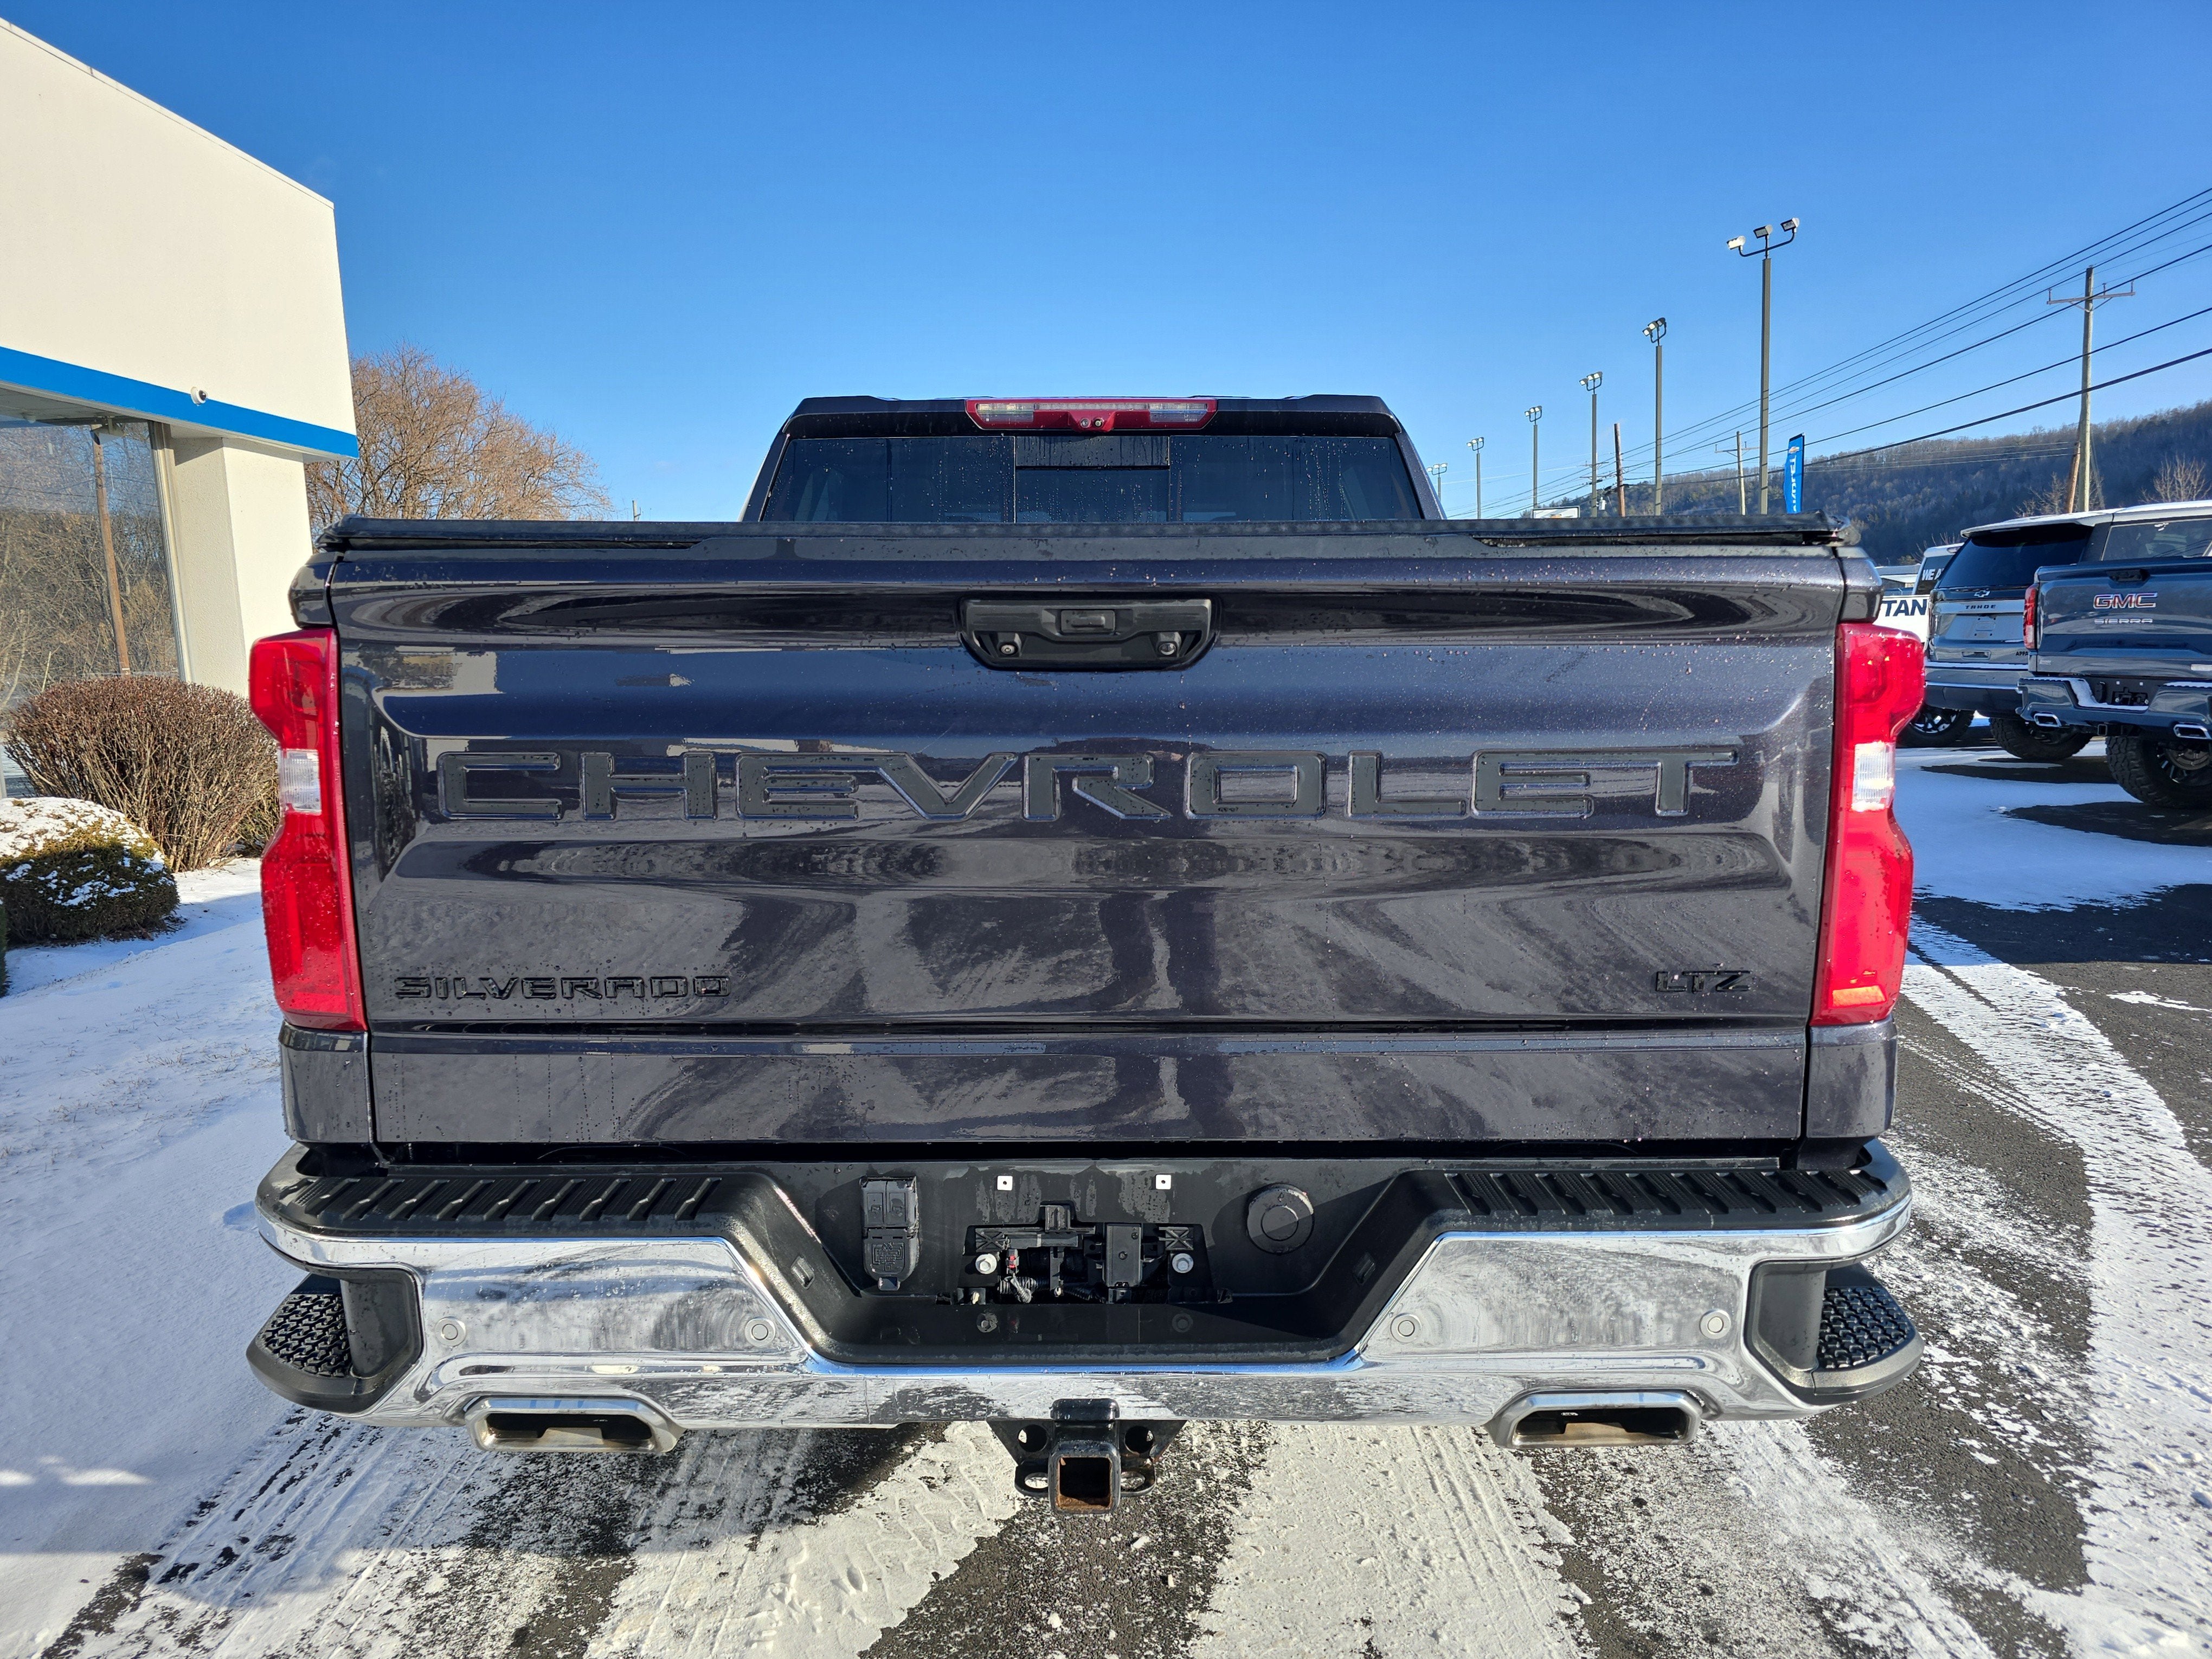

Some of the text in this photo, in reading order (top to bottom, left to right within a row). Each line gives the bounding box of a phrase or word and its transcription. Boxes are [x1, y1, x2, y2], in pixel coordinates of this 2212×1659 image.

[1922, 569, 1934, 581] WE
[2093, 592, 2158, 609] GMC
[437, 747, 1739, 821] CHEVROLET
[394, 975, 732, 1000] SILVERADO
[1656, 970, 1753, 993] LTZ
